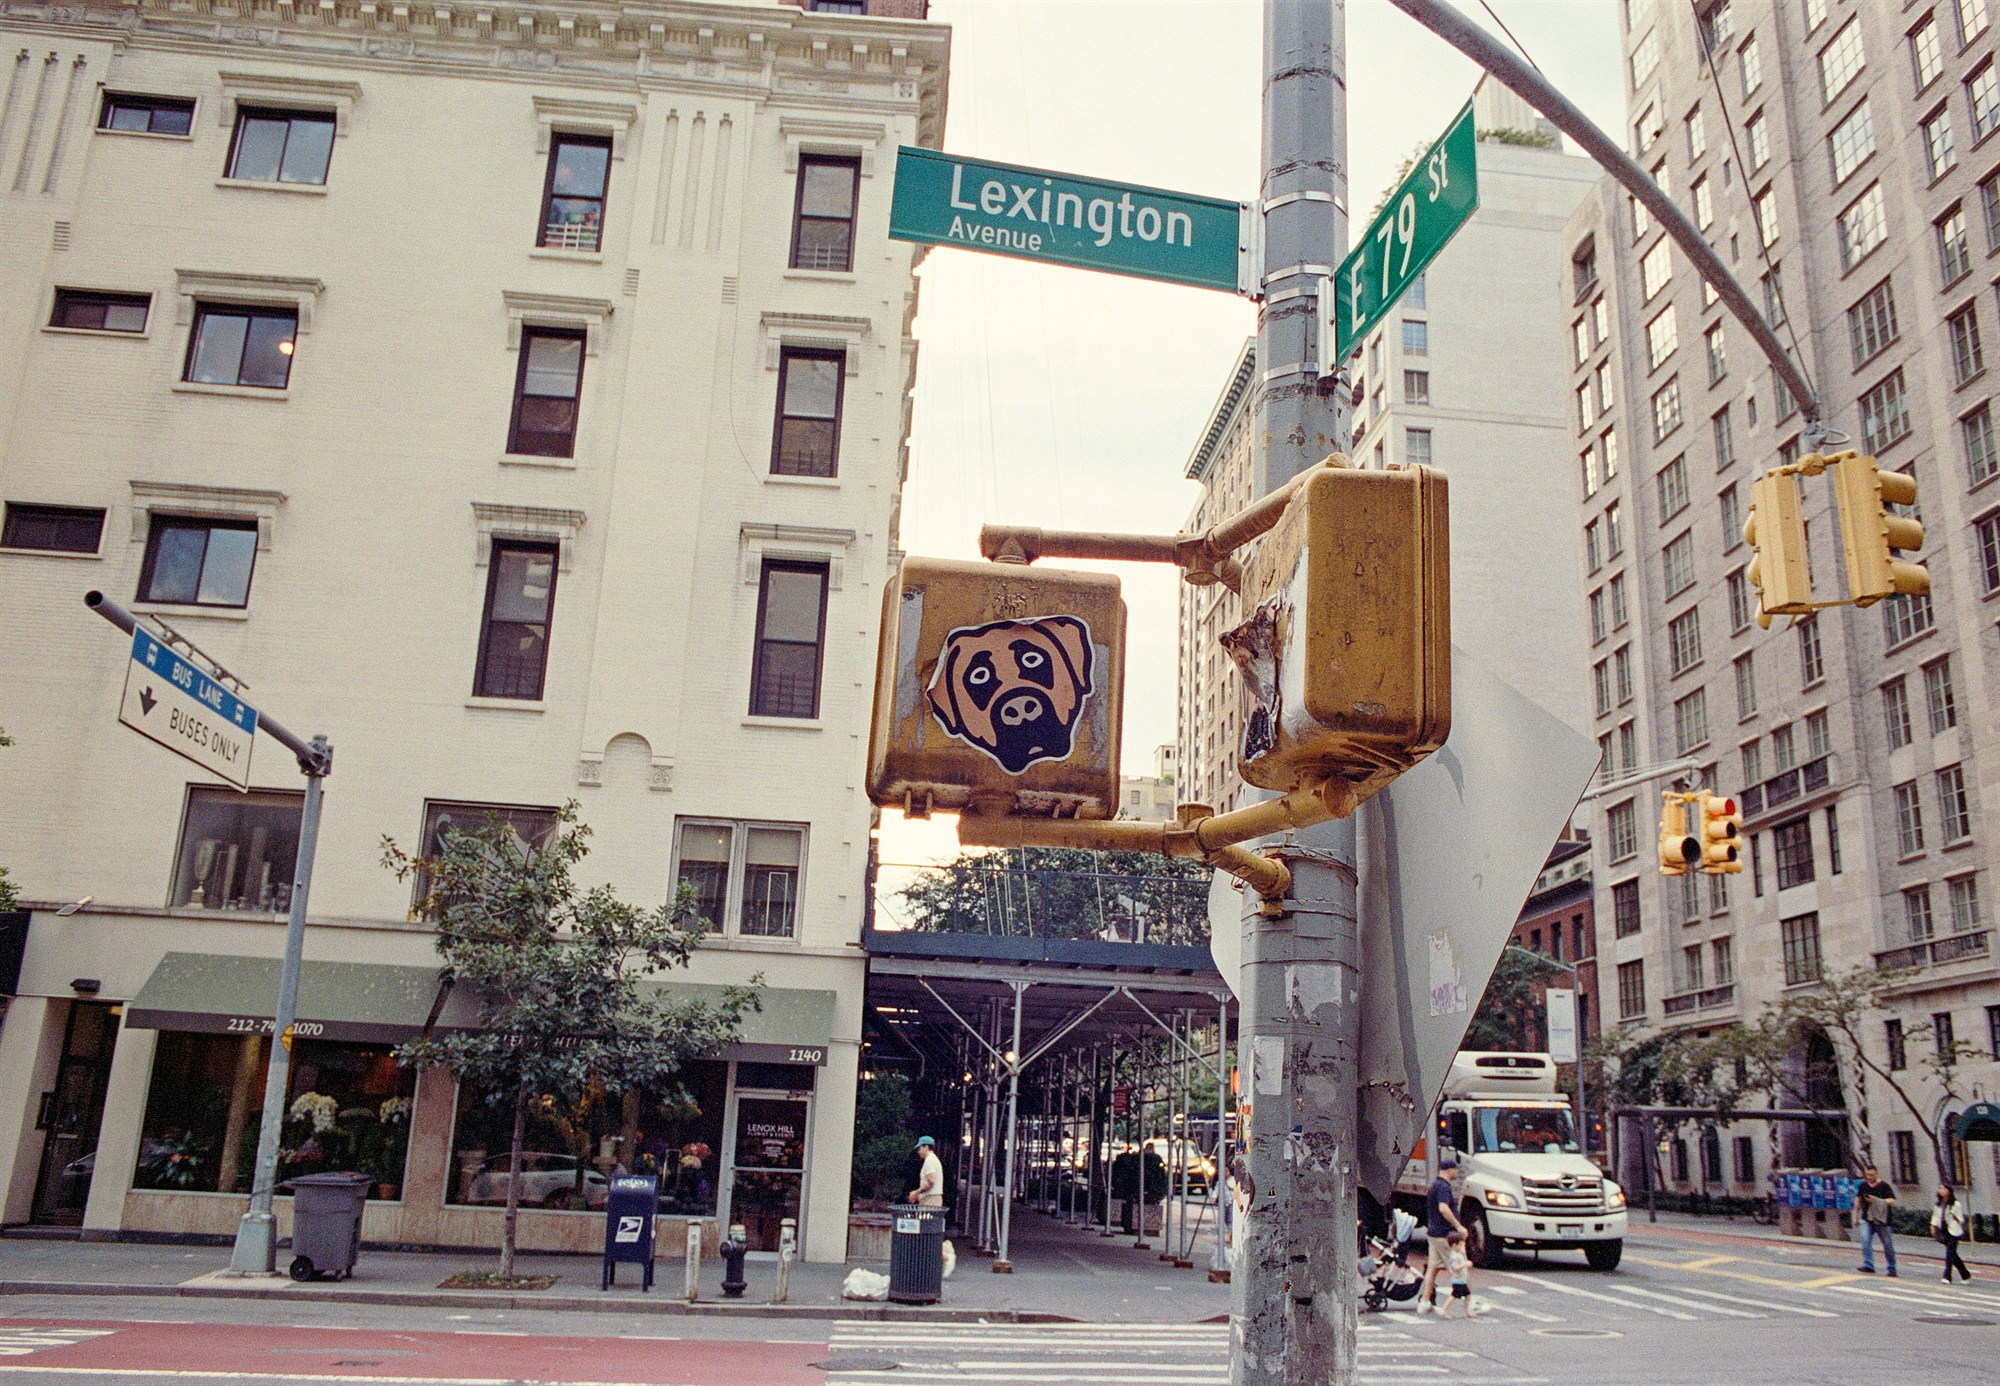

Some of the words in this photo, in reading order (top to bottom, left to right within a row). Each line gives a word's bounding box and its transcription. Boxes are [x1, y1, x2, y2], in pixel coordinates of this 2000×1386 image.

[950, 164, 1192, 247] Lexington
[948, 216, 1042, 251] Avenue
[1351, 253, 1366, 335] E
[1377, 193, 1416, 300] 79
[1428, 144, 1449, 202] St
[172, 662, 193, 688] BUS
[199, 680, 223, 710] LANE
[171, 708, 209, 746] BUSES
[212, 733, 240, 763] ONLY
[789, 1049, 822, 1063] 1140
[747, 1123, 776, 1133] LENOX
[777, 1125, 795, 1134] HILL
